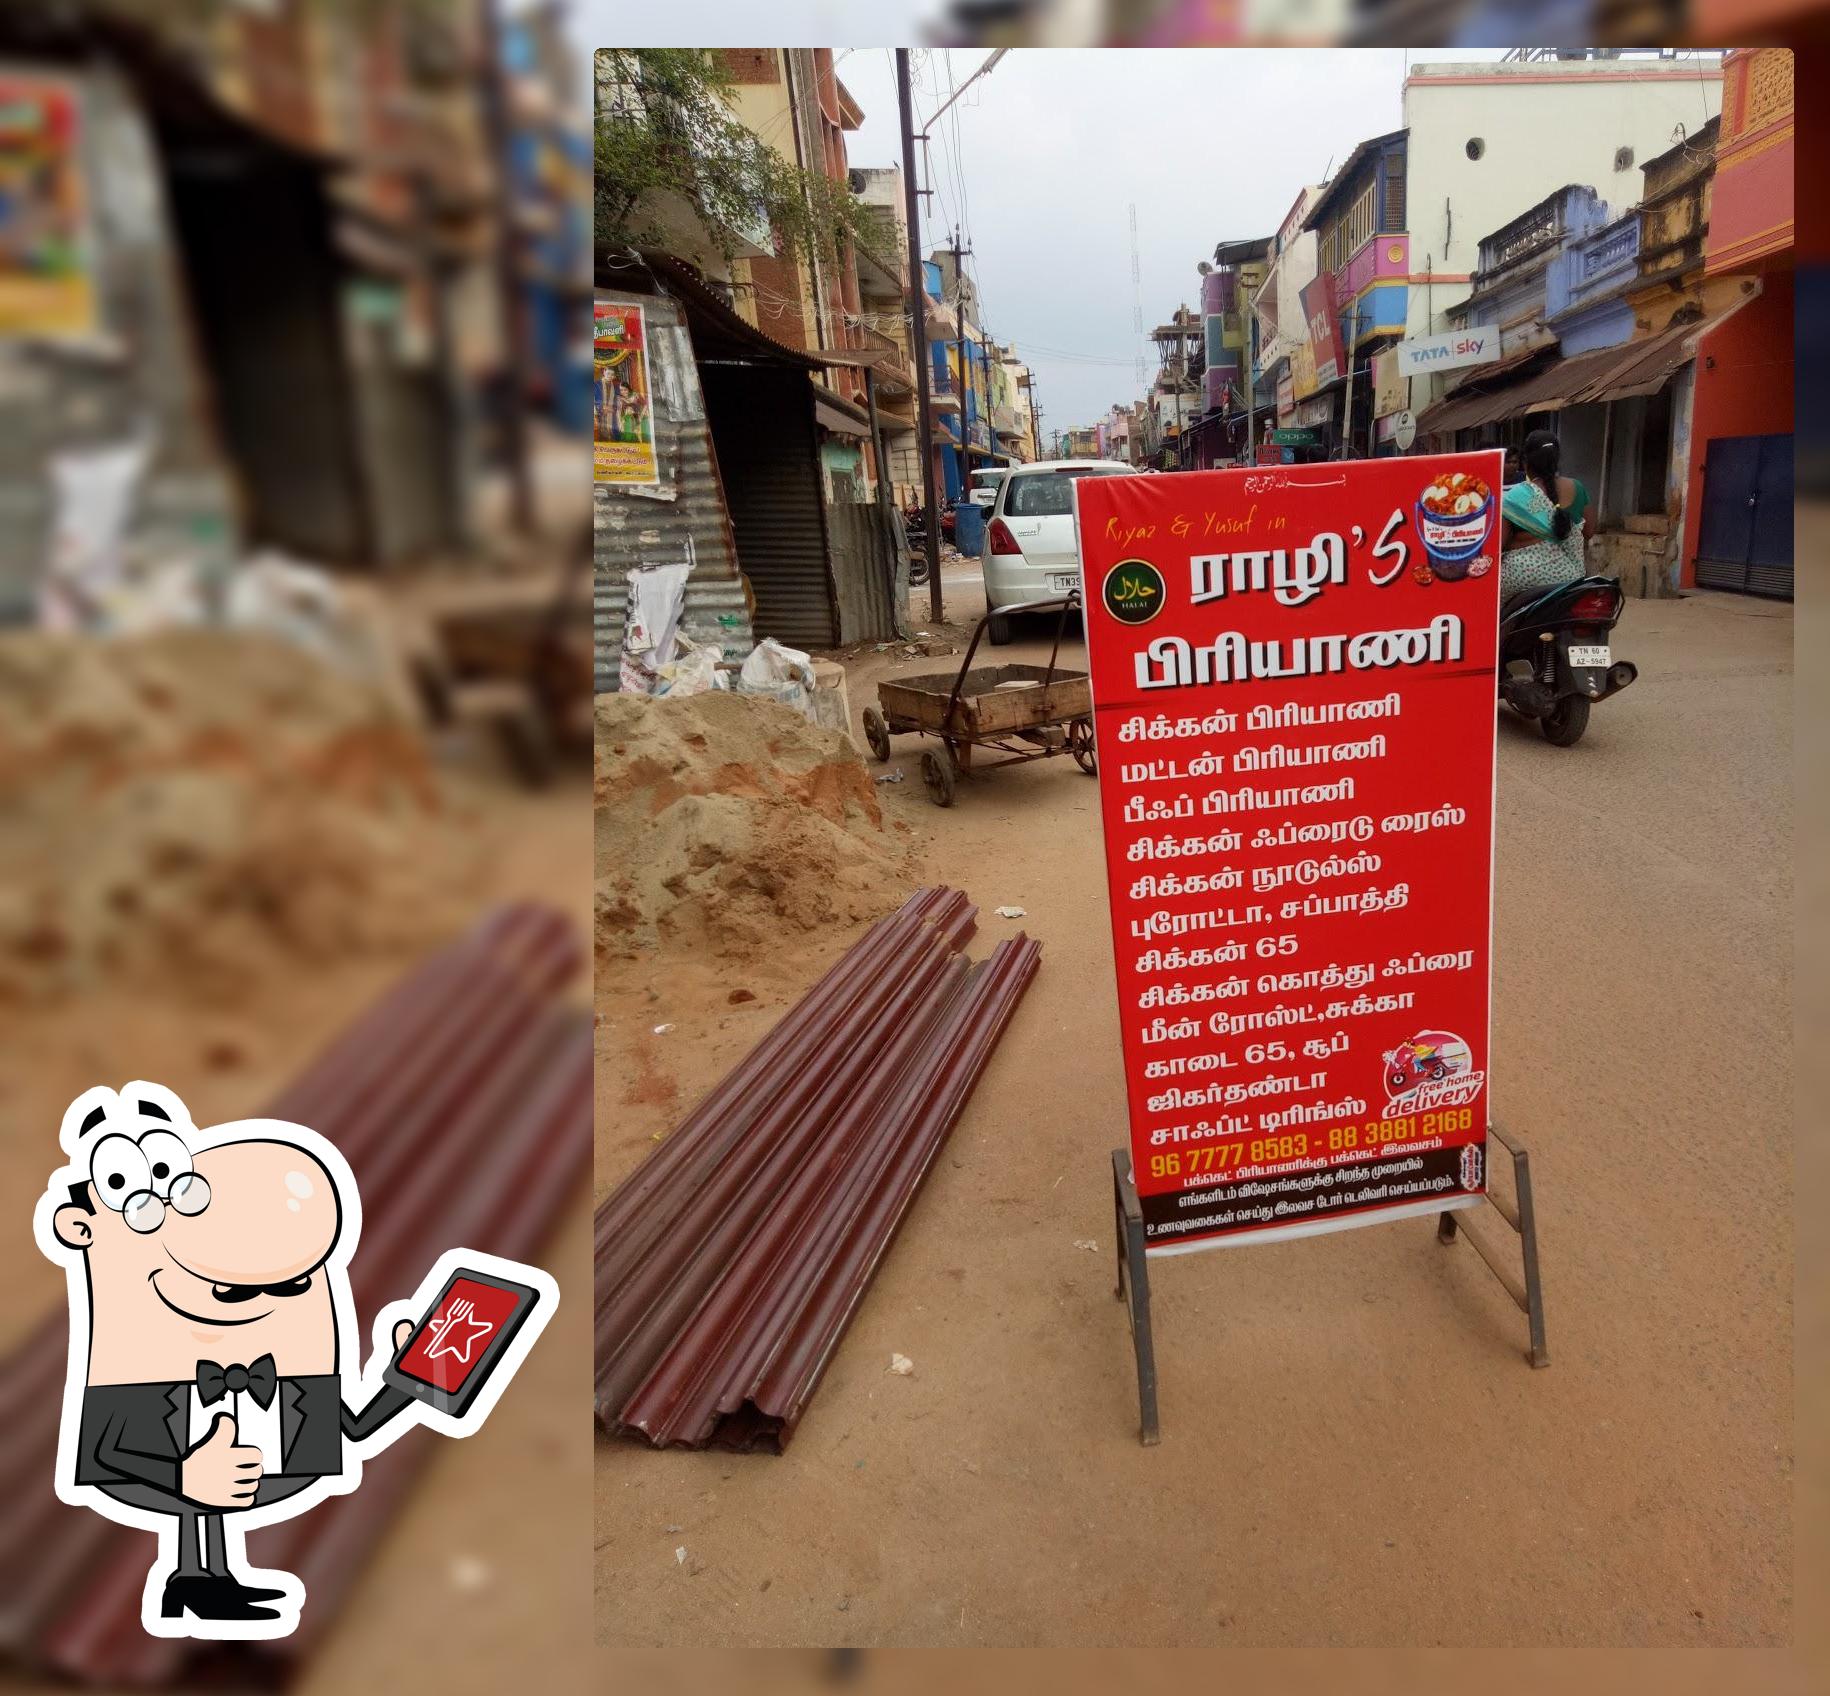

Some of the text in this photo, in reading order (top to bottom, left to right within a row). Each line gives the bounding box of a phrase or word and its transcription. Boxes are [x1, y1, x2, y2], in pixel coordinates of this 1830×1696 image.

[1411, 338, 1484, 362] TATA sky
[1278, 432, 1314, 442] oppo
[1106, 504, 1286, 549] Riyaz & Yusuf in
[1113, 576, 1156, 601] حلال
[1134, 614, 1462, 689] பிரியாணி
[1578, 647, 1589, 655] TN
[1118, 693, 1400, 742] சிக்கன் பிரியாணி
[1121, 734, 1386, 783] மட்டன் பிரியாணி
[1124, 777, 1354, 823] பீஃப் பிரியாணி
[1126, 803, 1465, 862] சிக்கன் ஃப்ரைடு ரைஸ்
[1129, 850, 1381, 900] சிக்கன் நூடுல்ஸ்
[1131, 883, 1409, 941] புரோட்டா, சப்பாத்தி
[1135, 934, 1299, 974] சிக்கன் 65
[1138, 950, 1474, 1009] சிக்கன் கொத்து ஃப்ரை
[1141, 1017, 1202, 1044] மீன்
[1144, 1031, 1349, 1079] காடை 65, சூப்
[1147, 1072, 1327, 1112] ஜிகர்தண்டா
[1386, 1084, 1478, 1117] delivery
[1418, 1071, 1481, 1093] free home
[1150, 1096, 1367, 1145] சாஃப்ட் டிரிங்ஸ்
[1151, 1153, 1181, 1178] 96
[1186, 1143, 1244, 1172] 7777
[1250, 1134, 1307, 1162] 8583
[1329, 1126, 1357, 1150] 88
[1365, 1117, 1416, 1145] 3881
[1423, 1108, 1472, 1136] 2168
[1178, 1187, 1237, 1208] எங்களிடம்
[1335, 1165, 1371, 1184] சிறந்த
[1371, 1156, 1424, 1177] முறையில்
[1184, 1170, 1233, 1188] பக்கெட்
[1331, 1147, 1378, 1165] பக்கெட்
[1381, 1136, 1443, 1156] இலவசம்
[1236, 1205, 1274, 1222] செய்து
[1275, 1199, 1316, 1216] இலவச
[1316, 1192, 1343, 1209] டோர்
[1344, 1187, 1388, 1203] டெலிவரி
